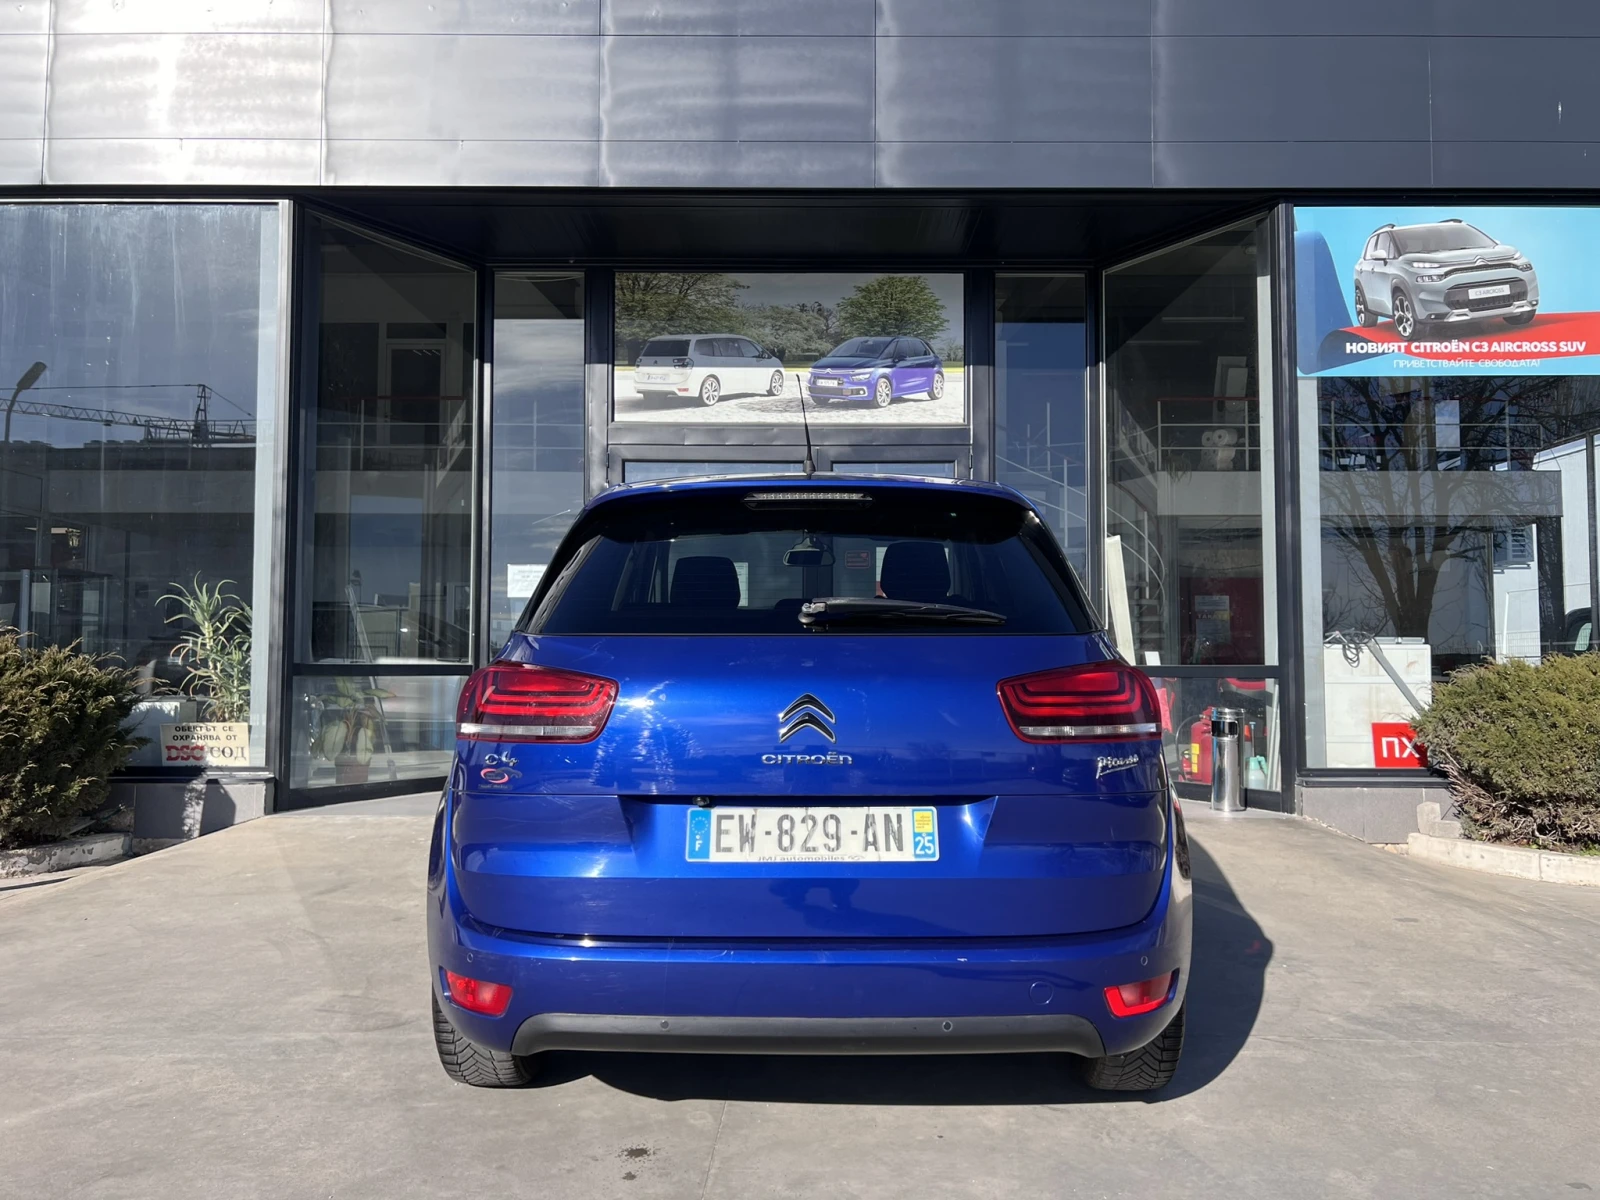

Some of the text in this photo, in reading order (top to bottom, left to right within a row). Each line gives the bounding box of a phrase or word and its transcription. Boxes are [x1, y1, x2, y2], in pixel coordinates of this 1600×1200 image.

[1345, 339, 1586, 354] НОВИЯТ CITROËN C3 AIRCROSS SUV
[1393, 358, 1541, 368] ПРИВЕТСТВАЙТЕ СВОБОДАТА!
[174, 725, 217, 733] ОБЕКТЪТ
[165, 745, 247, 761] DSC СОД
[484, 751, 518, 767] C4
[1095, 753, 1140, 780] Picasso
[715, 813, 904, 853] EW-829-AN
[695, 841, 702, 852] F
[914, 835, 935, 855] 25
